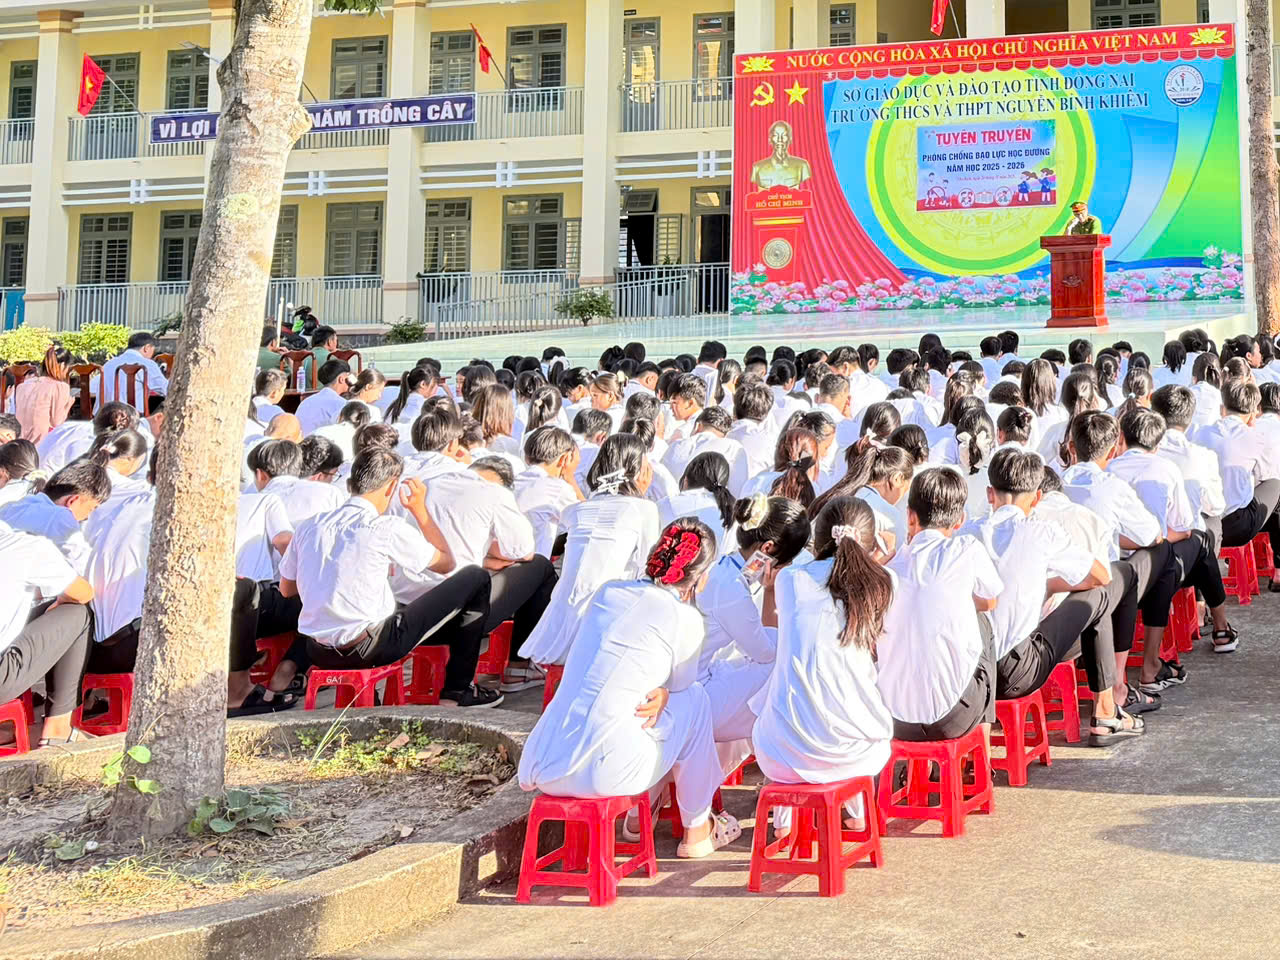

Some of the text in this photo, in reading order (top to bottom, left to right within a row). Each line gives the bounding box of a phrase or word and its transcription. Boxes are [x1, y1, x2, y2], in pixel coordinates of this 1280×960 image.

[787, 31, 1177, 68] NƯỚC CỘNG HÒA XÃ HỘI CHỦ NGHĨA VIỆT NAM
[864, 83, 900, 102] GIÁO
[904, 84, 932, 102] DỤC
[936, 79, 955, 97] VÀ
[959, 78, 989, 96] ĐÀO
[991, 79, 1021, 97] TẠO
[1109, 72, 1135, 88] NAI
[310, 100, 468, 128] NĂM TRỒNG CÂY
[894, 103, 930, 120] THCS
[933, 100, 952, 118] VÀ
[956, 101, 992, 117] THPT
[1099, 89, 1149, 109] KHIÊM
[159, 120, 176, 138] VÌ
[182, 119, 209, 140] LỢI
[936, 129, 977, 145] TUYÊN
[975, 150, 990, 161] BẠO
[1007, 148, 1023, 158] HỌC
[982, 162, 1000, 172] 2025
[1006, 161, 1025, 170] 2026
